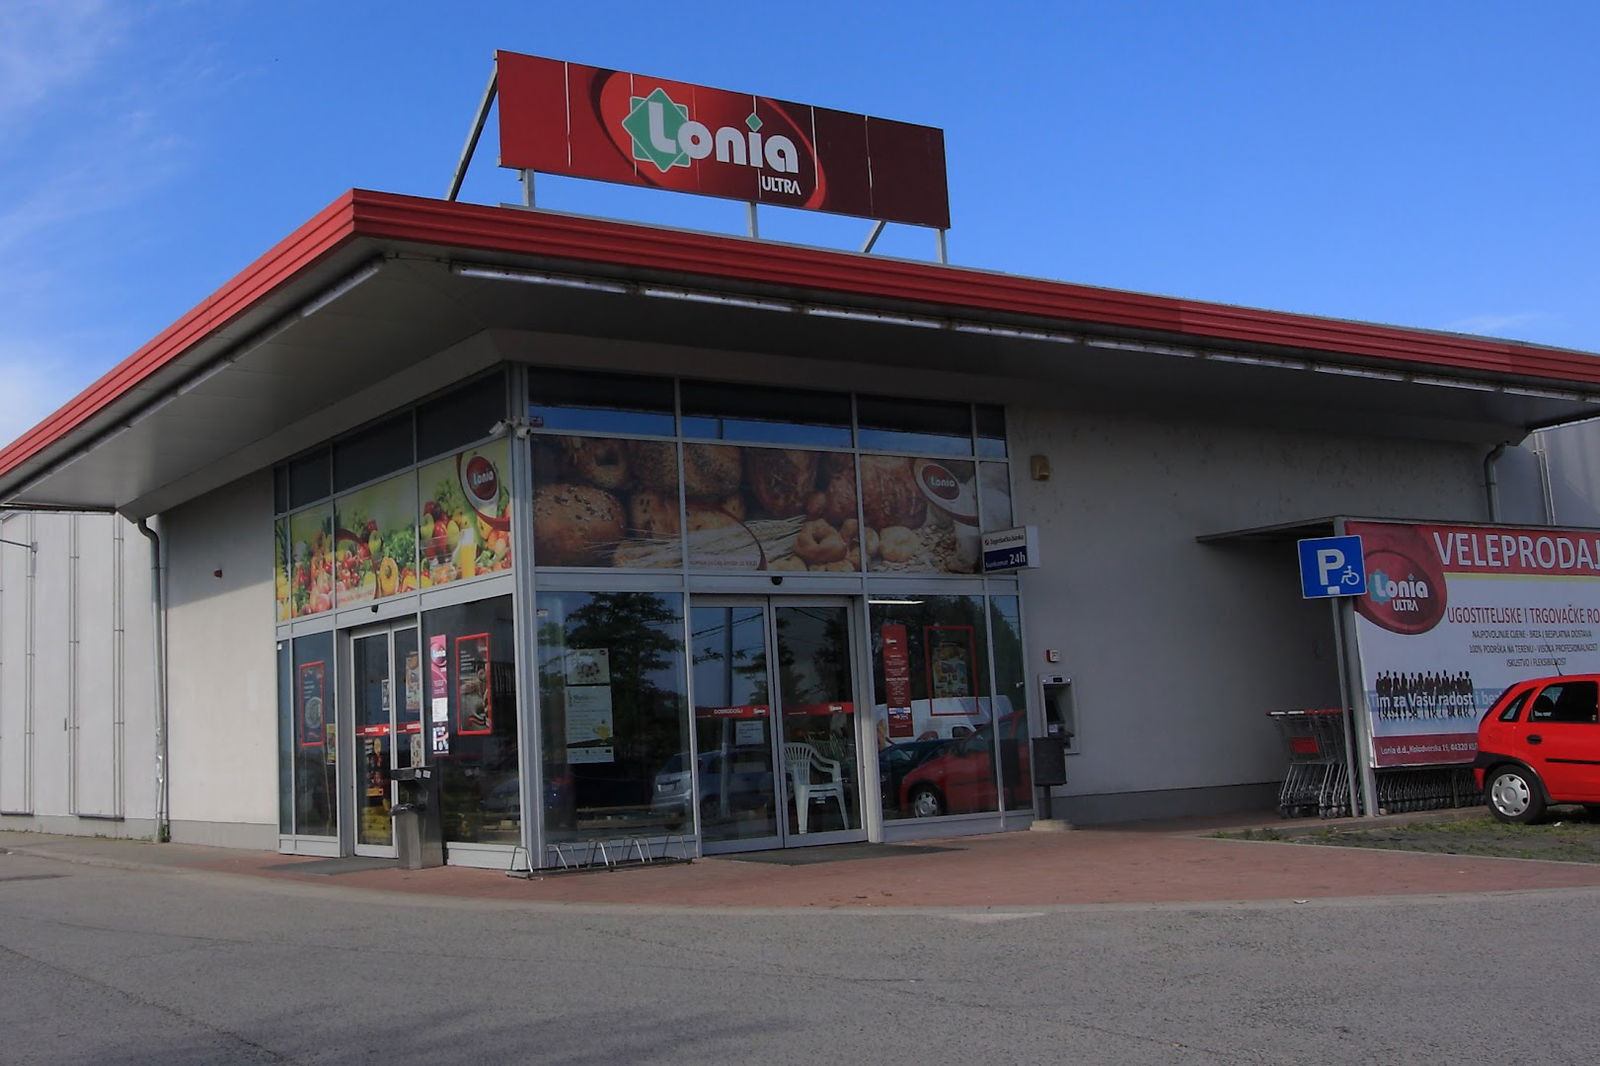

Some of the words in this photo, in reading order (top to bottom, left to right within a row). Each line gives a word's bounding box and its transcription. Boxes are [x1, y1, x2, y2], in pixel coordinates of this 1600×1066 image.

[648, 101, 799, 174] Lonia
[762, 176, 801, 195] ULTRA
[1009, 552, 1026, 565] 24h
[1316, 549, 1345, 585] P
[1374, 574, 1429, 598] Lonia
[1393, 600, 1419, 611] ULTRA
[1447, 607, 1522, 623] UGOSTITELJSKE
[1529, 604, 1584, 624] TRGOVAČKE
[1393, 697, 1408, 707] za
[1408, 692, 1435, 707] Vašu
[1438, 691, 1473, 706] radost
